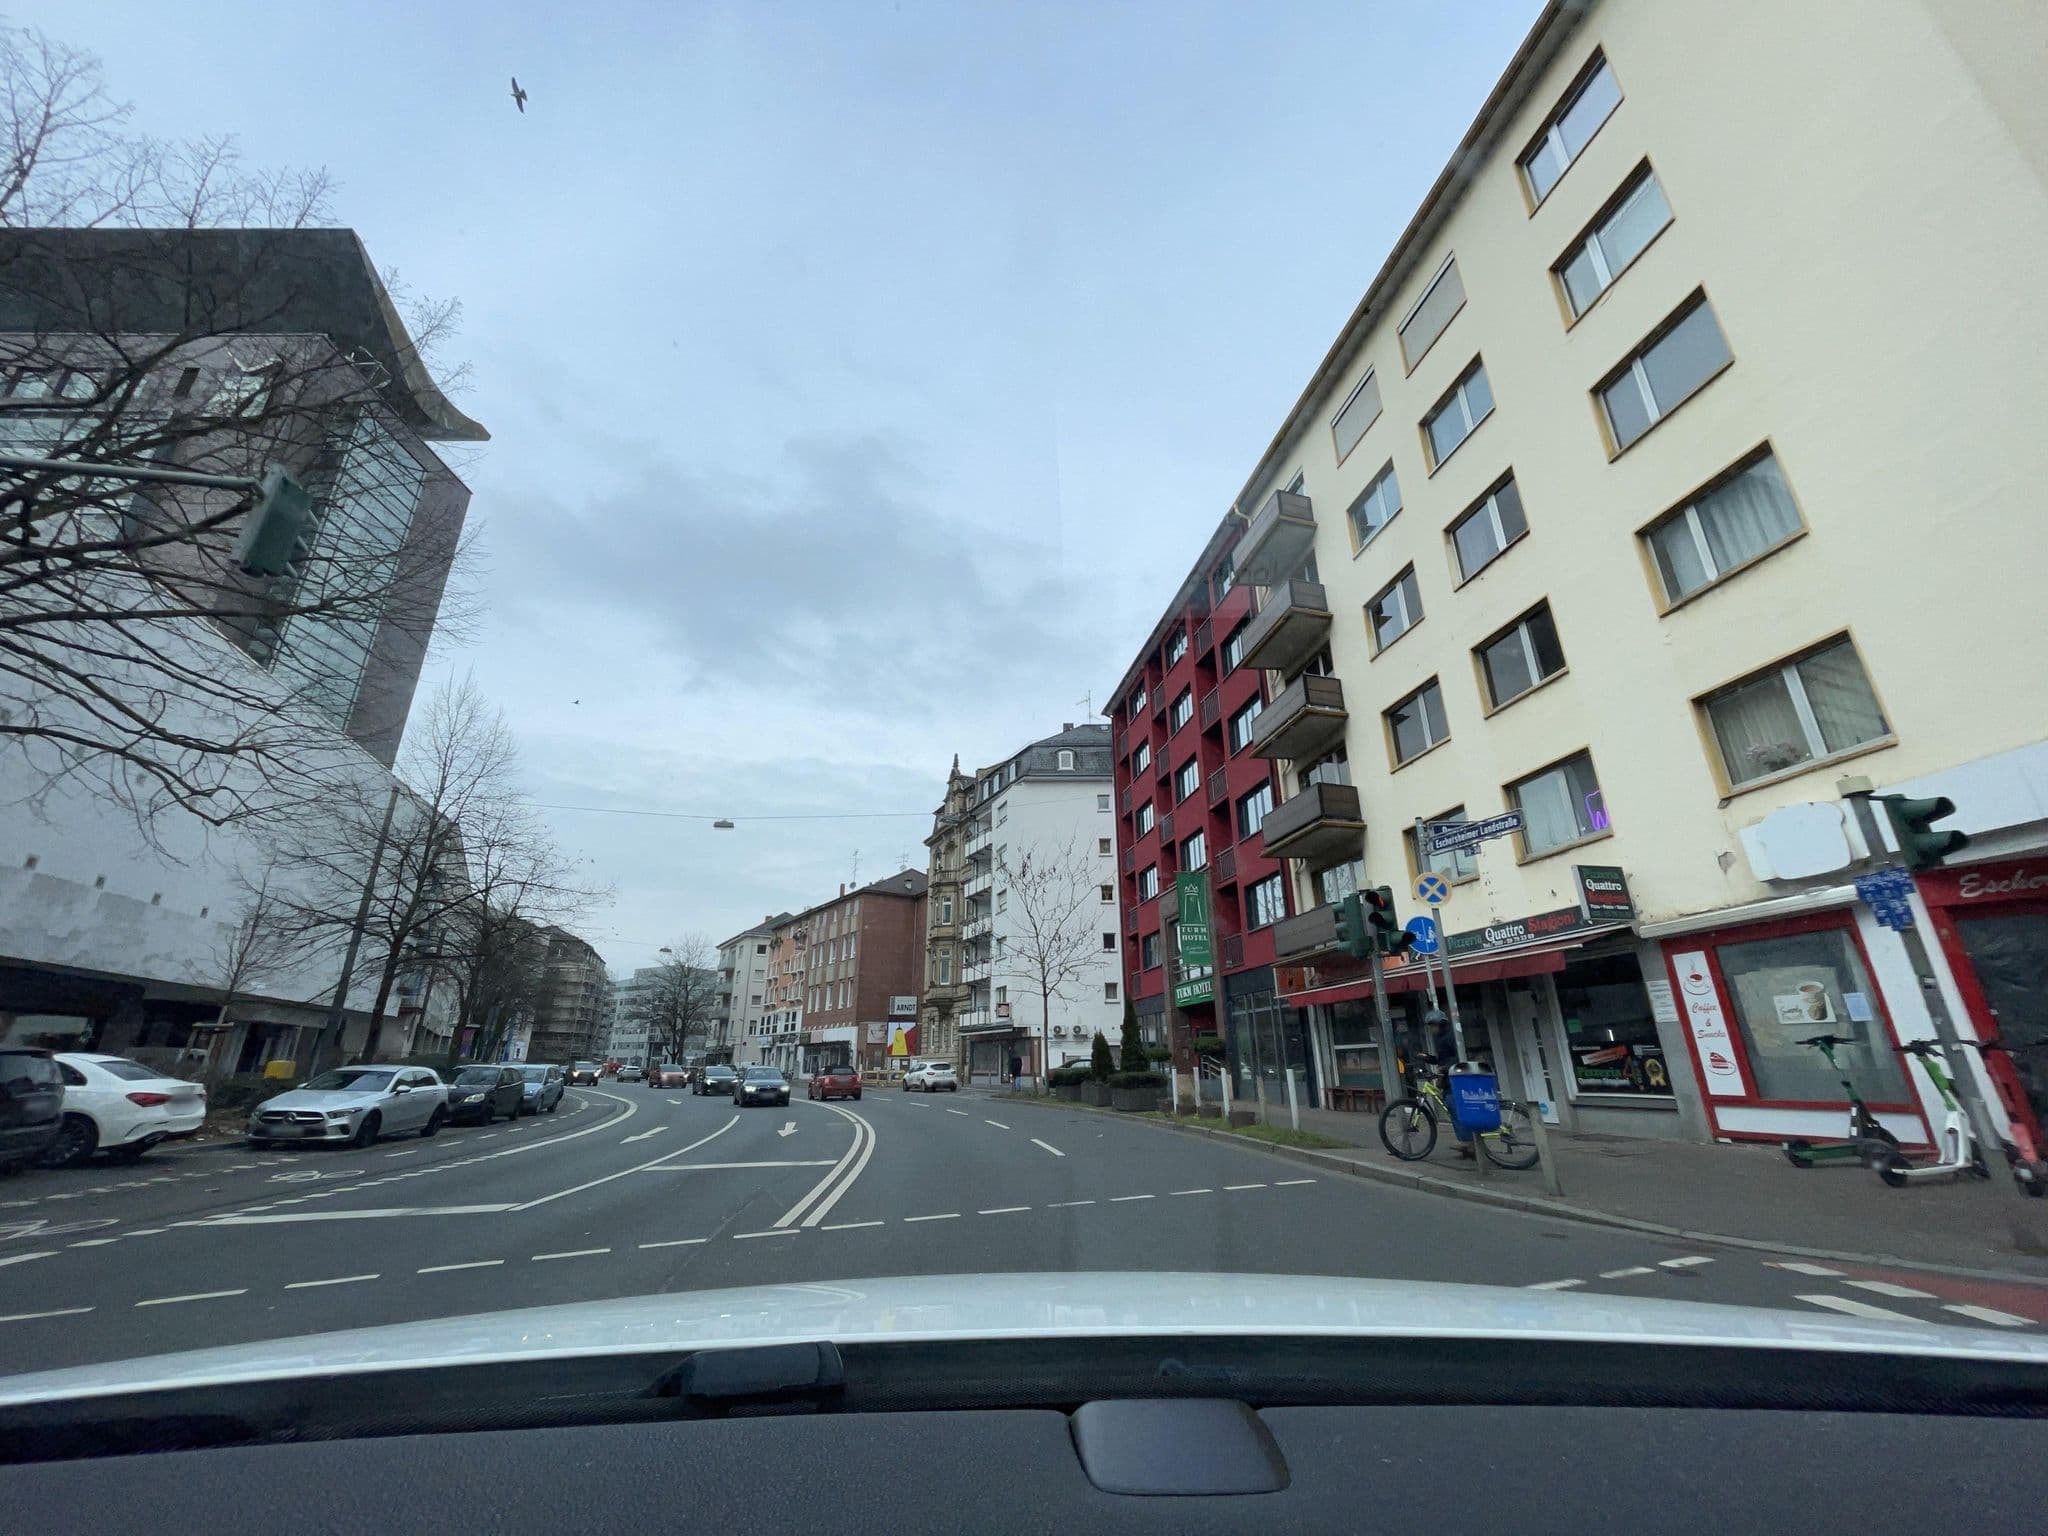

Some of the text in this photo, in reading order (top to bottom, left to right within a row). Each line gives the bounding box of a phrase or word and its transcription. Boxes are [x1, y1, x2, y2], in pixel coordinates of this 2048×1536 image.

[1435, 816, 1518, 849] Eschersheimer Landstraße
[1585, 878, 1622, 892] Quattro
[1181, 926, 1207, 934] TURM
[1182, 934, 1208, 942] HOTEL
[1485, 923, 1525, 943] Quattro
[1176, 981, 1212, 1000] TURM HOTEL
